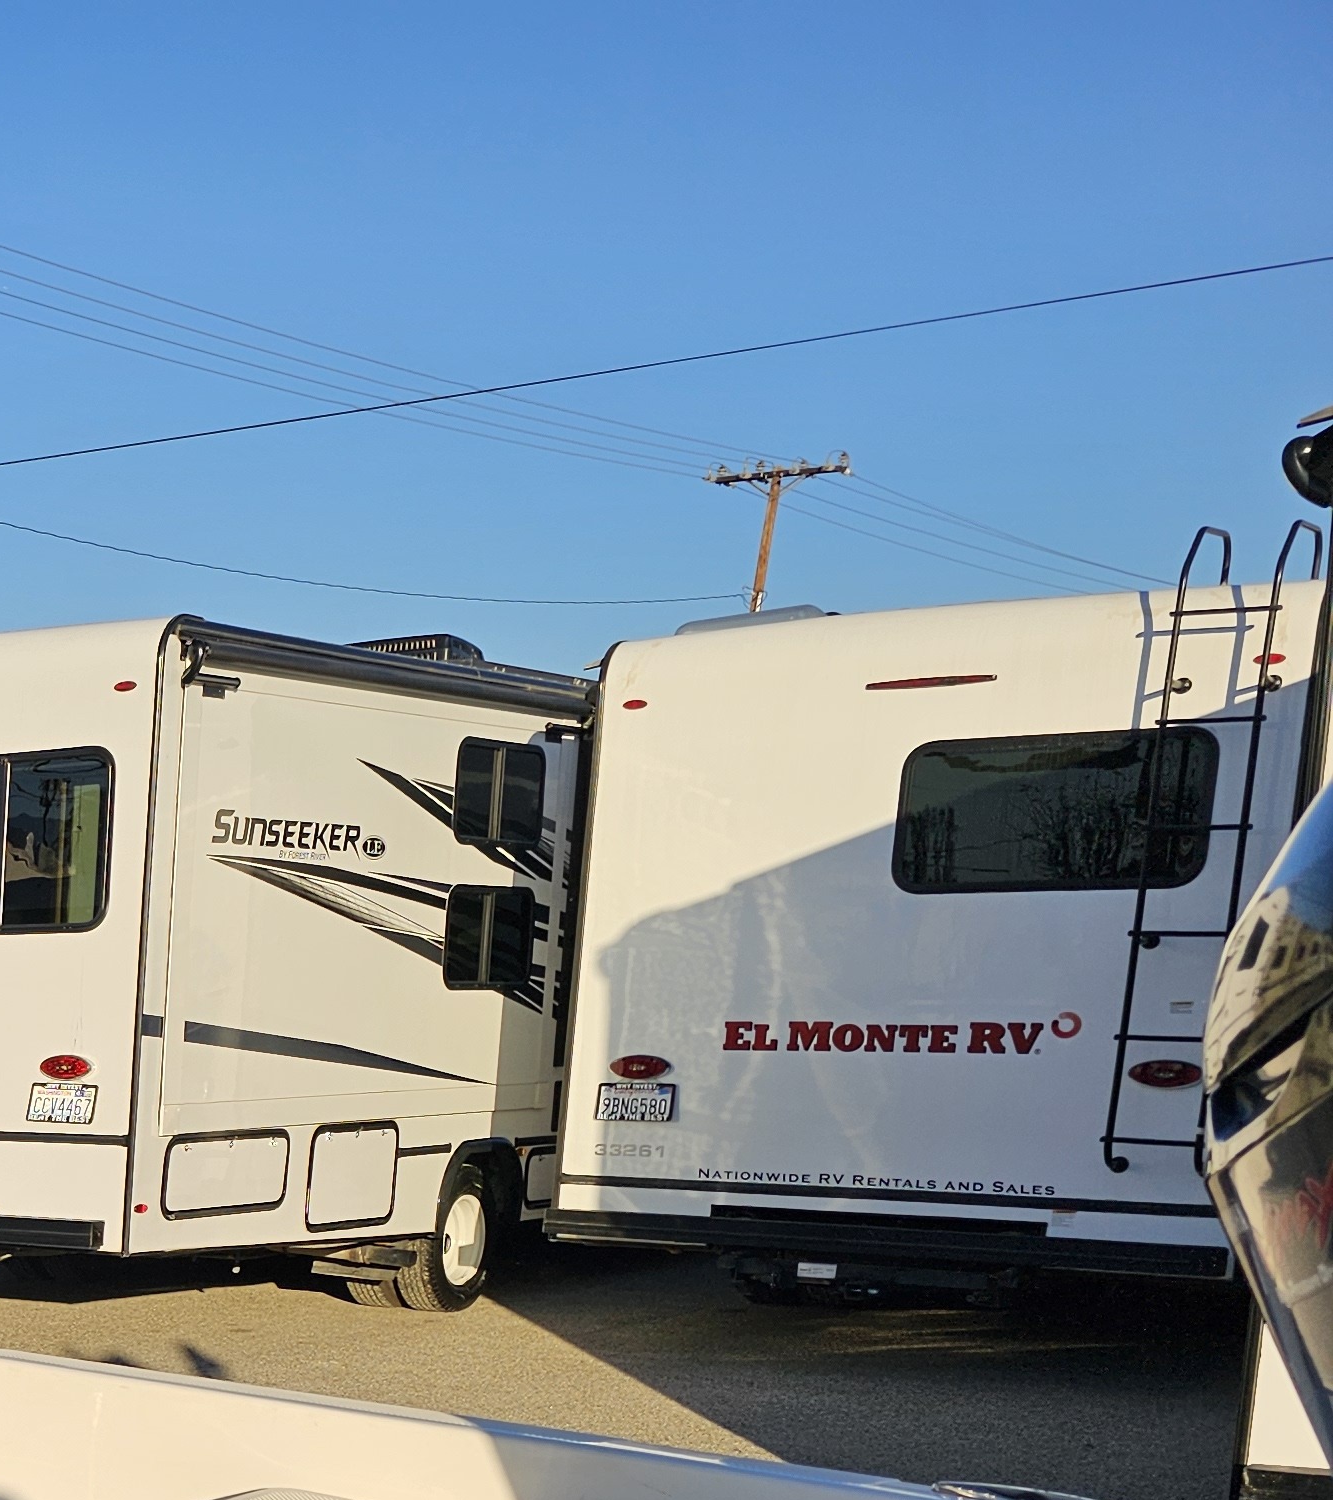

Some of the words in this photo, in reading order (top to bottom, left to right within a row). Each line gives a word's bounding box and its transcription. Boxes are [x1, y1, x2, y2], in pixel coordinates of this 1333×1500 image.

[366, 840, 384, 855] LE
[722, 1021, 779, 1052] EL
[786, 1021, 959, 1054] MONTE
[966, 1022, 1045, 1055] RV
[33, 1096, 92, 1118] CCV4467
[600, 1097, 668, 1116] 9BNG580
[594, 1143, 665, 1158] 33261
[698, 1168, 811, 1184] NATIONWIDE
[819, 1173, 844, 1185] RV
[852, 1174, 937, 1190] RENTALS
[944, 1181, 984, 1192] AND
[992, 1181, 1055, 1196] SALES
